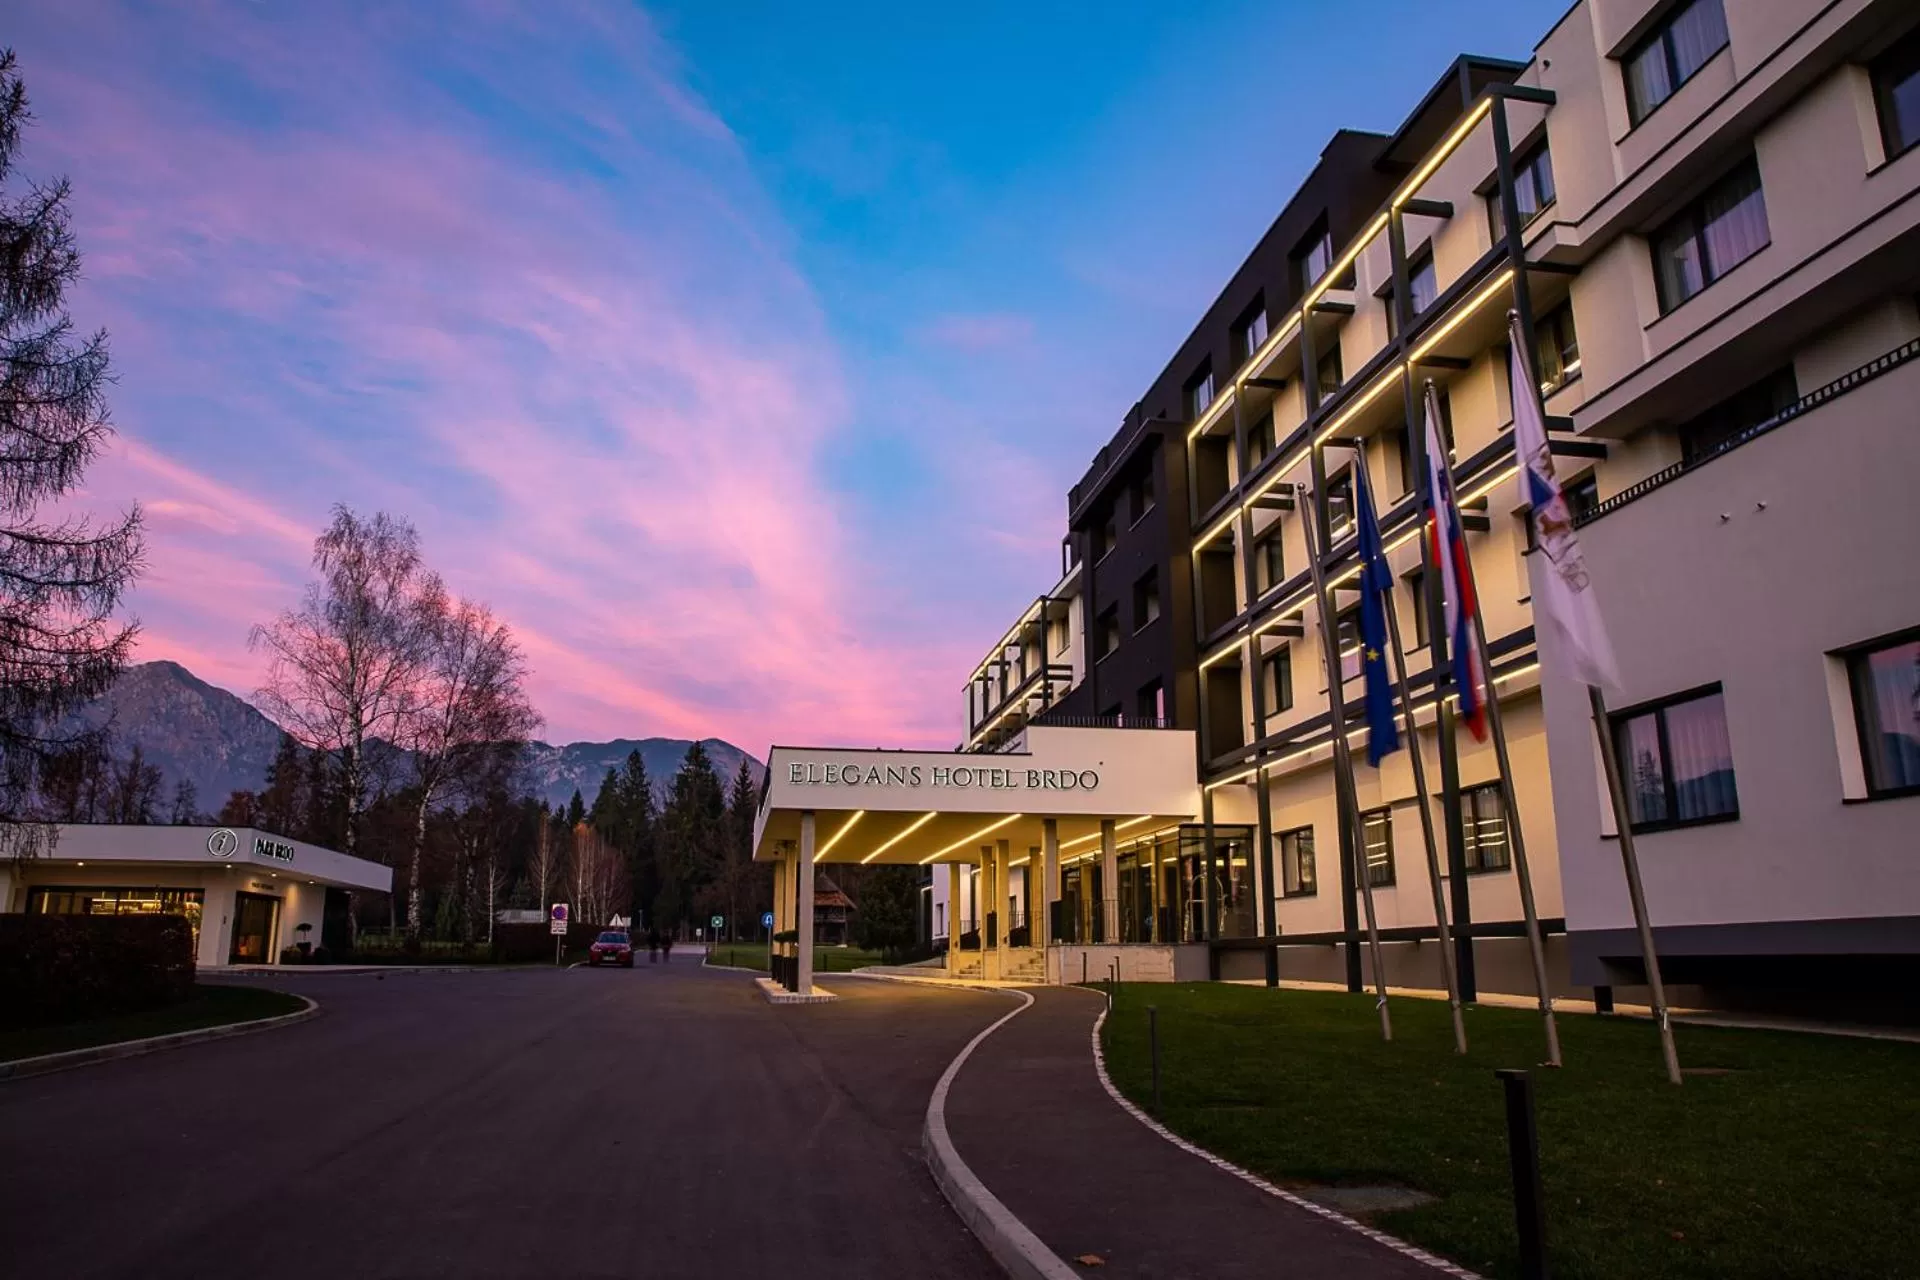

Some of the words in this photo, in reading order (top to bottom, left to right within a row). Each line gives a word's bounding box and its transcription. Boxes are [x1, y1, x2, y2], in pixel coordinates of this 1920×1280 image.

[789, 763, 921, 787] ELEGANS
[931, 766, 1018, 788] HOTEL
[1025, 769, 1100, 790] BRDO
